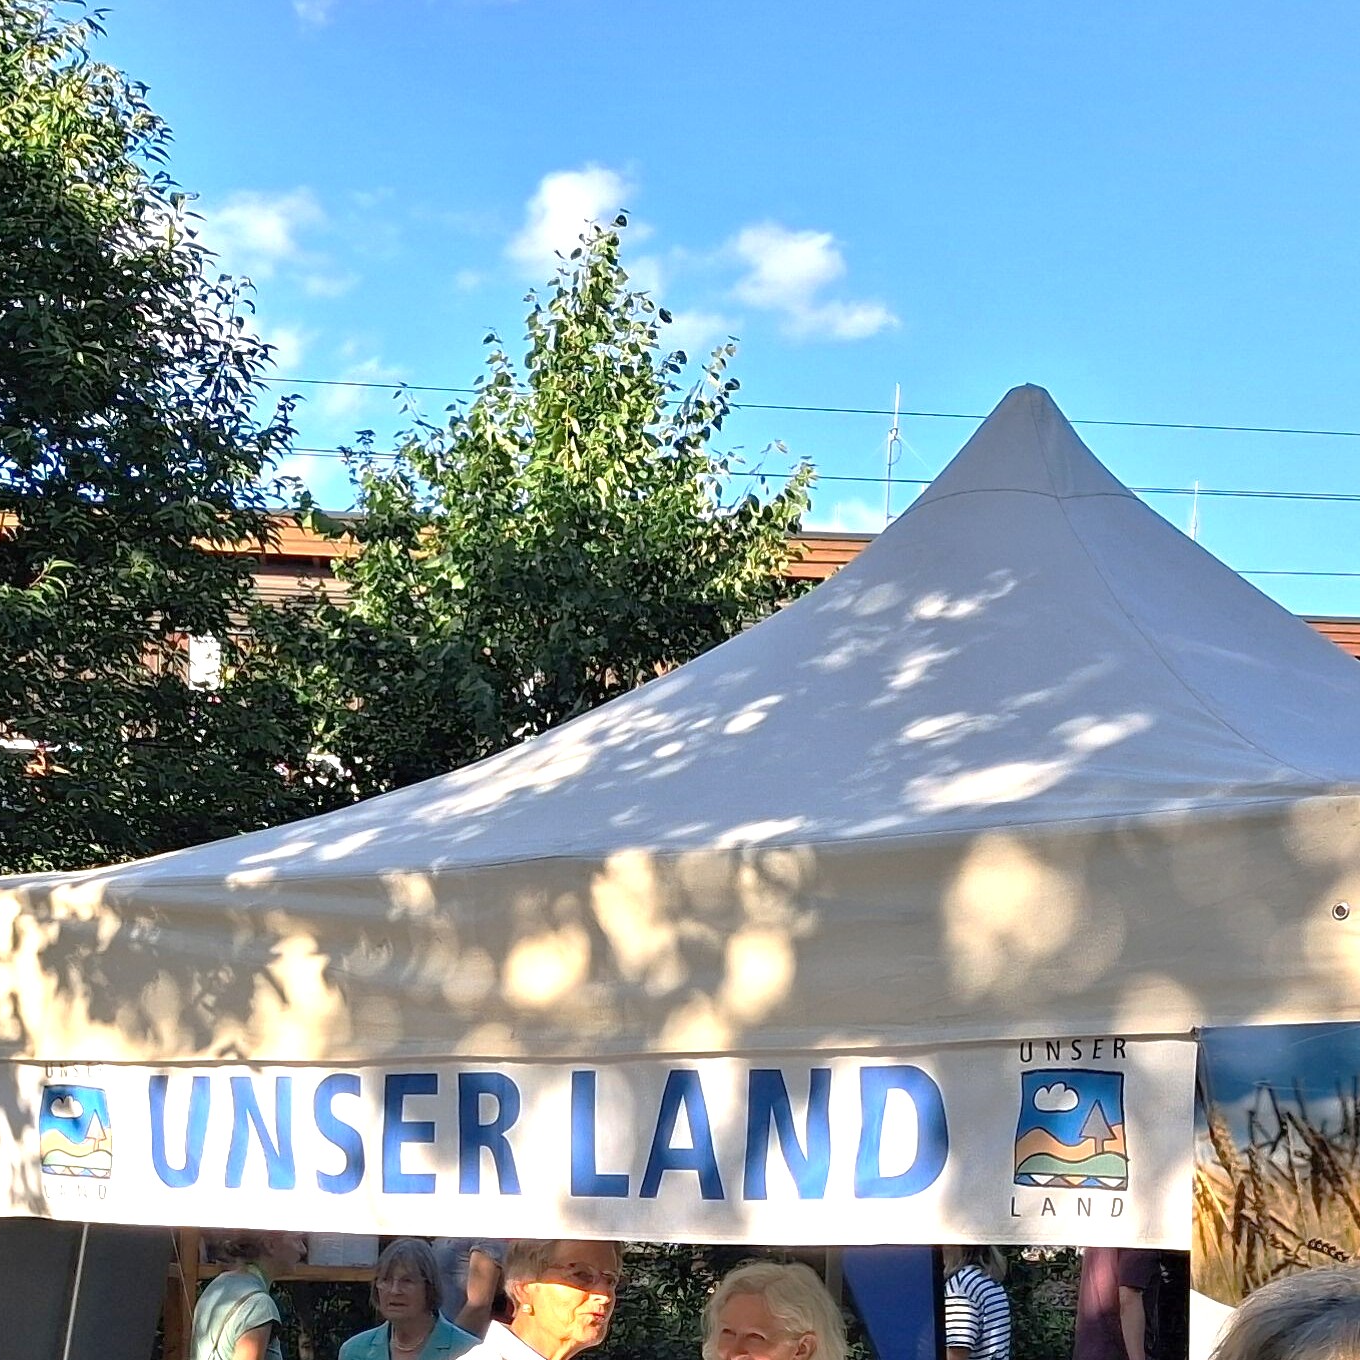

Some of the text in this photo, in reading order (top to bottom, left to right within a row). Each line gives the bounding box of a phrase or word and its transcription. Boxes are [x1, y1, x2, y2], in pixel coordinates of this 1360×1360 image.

[1020, 1038, 1127, 1063] UNSER
[148, 1065, 949, 1200] UNSER LAND
[1011, 1197, 1124, 1219] LAND
